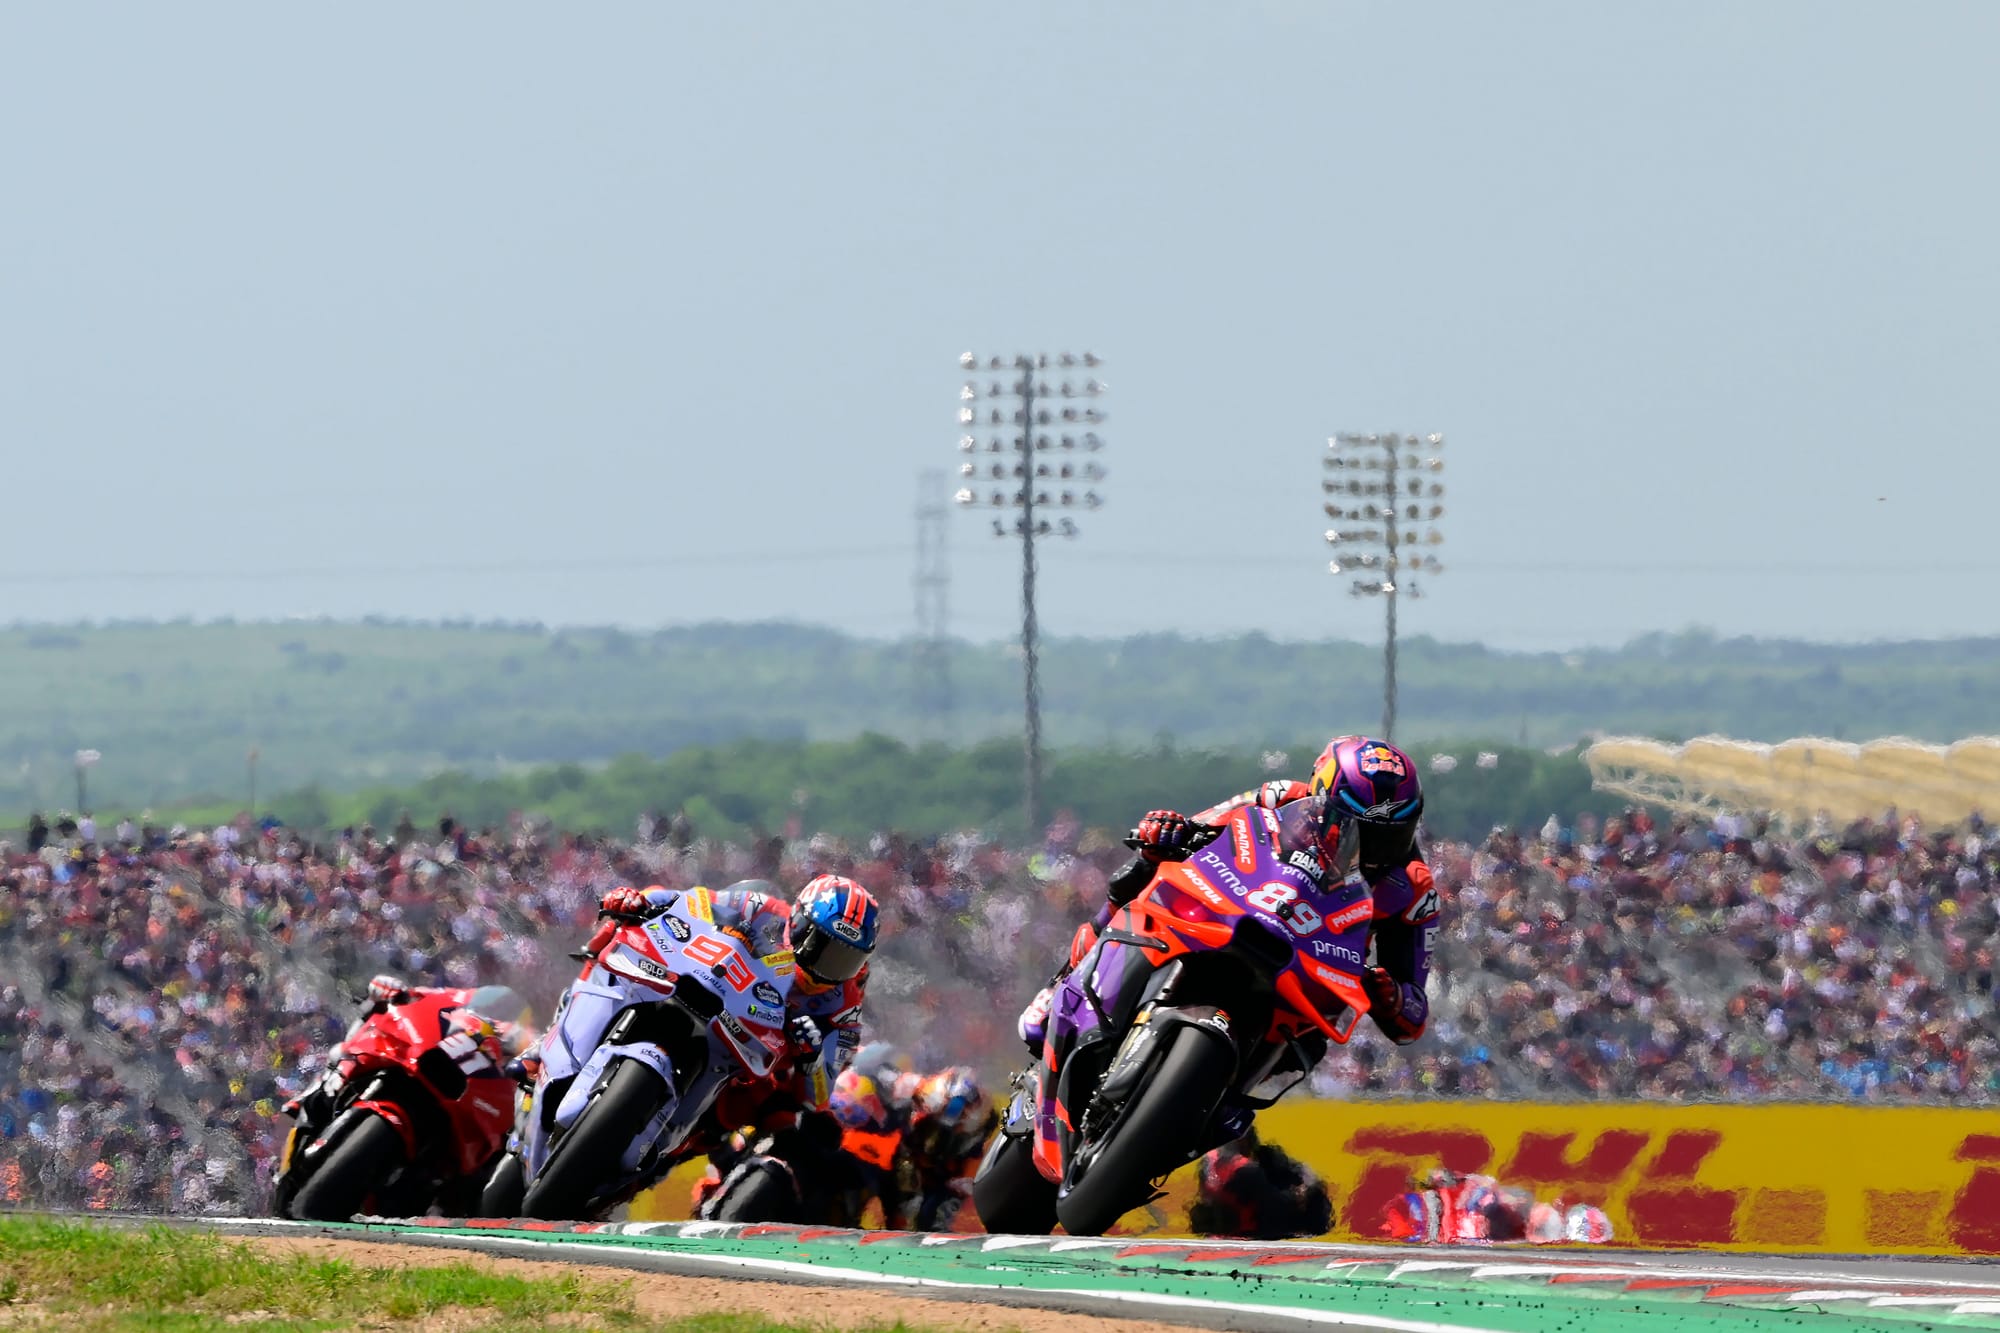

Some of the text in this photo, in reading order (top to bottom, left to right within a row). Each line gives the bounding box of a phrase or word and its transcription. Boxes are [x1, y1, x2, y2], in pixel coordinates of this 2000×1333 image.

[1234, 818, 1251, 864] PRAMAC
[1199, 851, 1248, 897] prima
[1281, 864, 1318, 892] prima
[1289, 850, 1325, 881] FIAMM
[1182, 868, 1224, 905] MOTUL
[1246, 880, 1323, 937] 89
[1332, 905, 1373, 928] PRAMAC
[1254, 911, 1295, 942] PRAMAC
[681, 933, 758, 994] 93
[1312, 940, 1361, 964] prima
[640, 960, 664, 977] BOLD
[1316, 965, 1359, 989] MOTUL
[720, 1010, 742, 1034] BOLD
[1342, 1124, 1738, 1244] DHL
